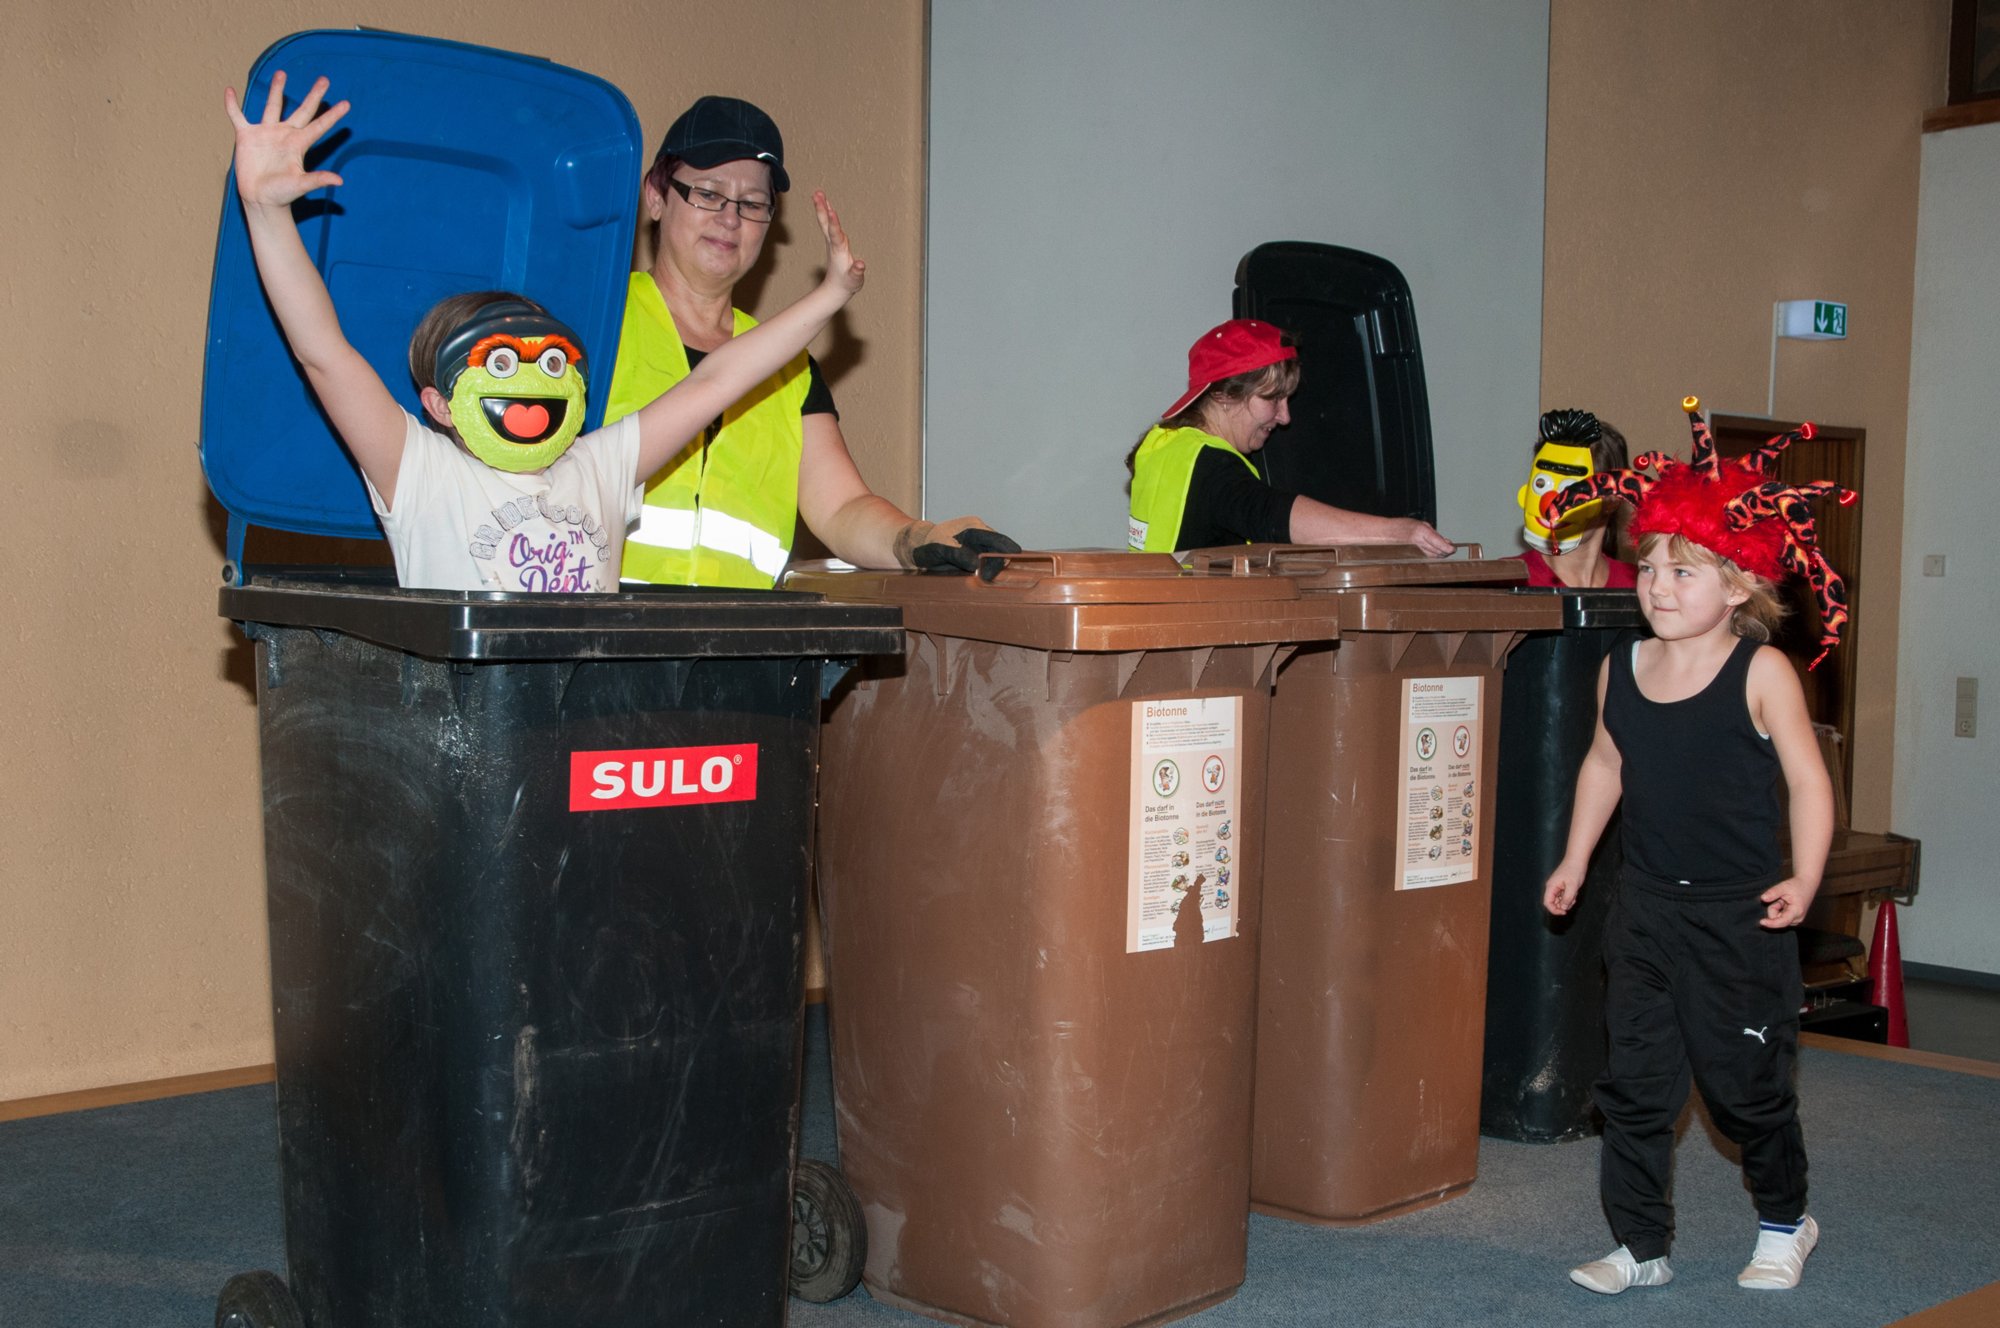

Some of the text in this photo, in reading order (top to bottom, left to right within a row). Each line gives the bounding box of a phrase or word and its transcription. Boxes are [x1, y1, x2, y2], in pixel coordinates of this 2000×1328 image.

[509, 533, 574, 576] Orig.
[1412, 683, 1444, 693] Biotonne
[1146, 706, 1188, 718] Biotonne
[1157, 804, 1168, 812] darf
[1196, 801, 1205, 809] Das
[1208, 809, 1227, 817] Biotonne
[1154, 814, 1180, 822] Biotonne
